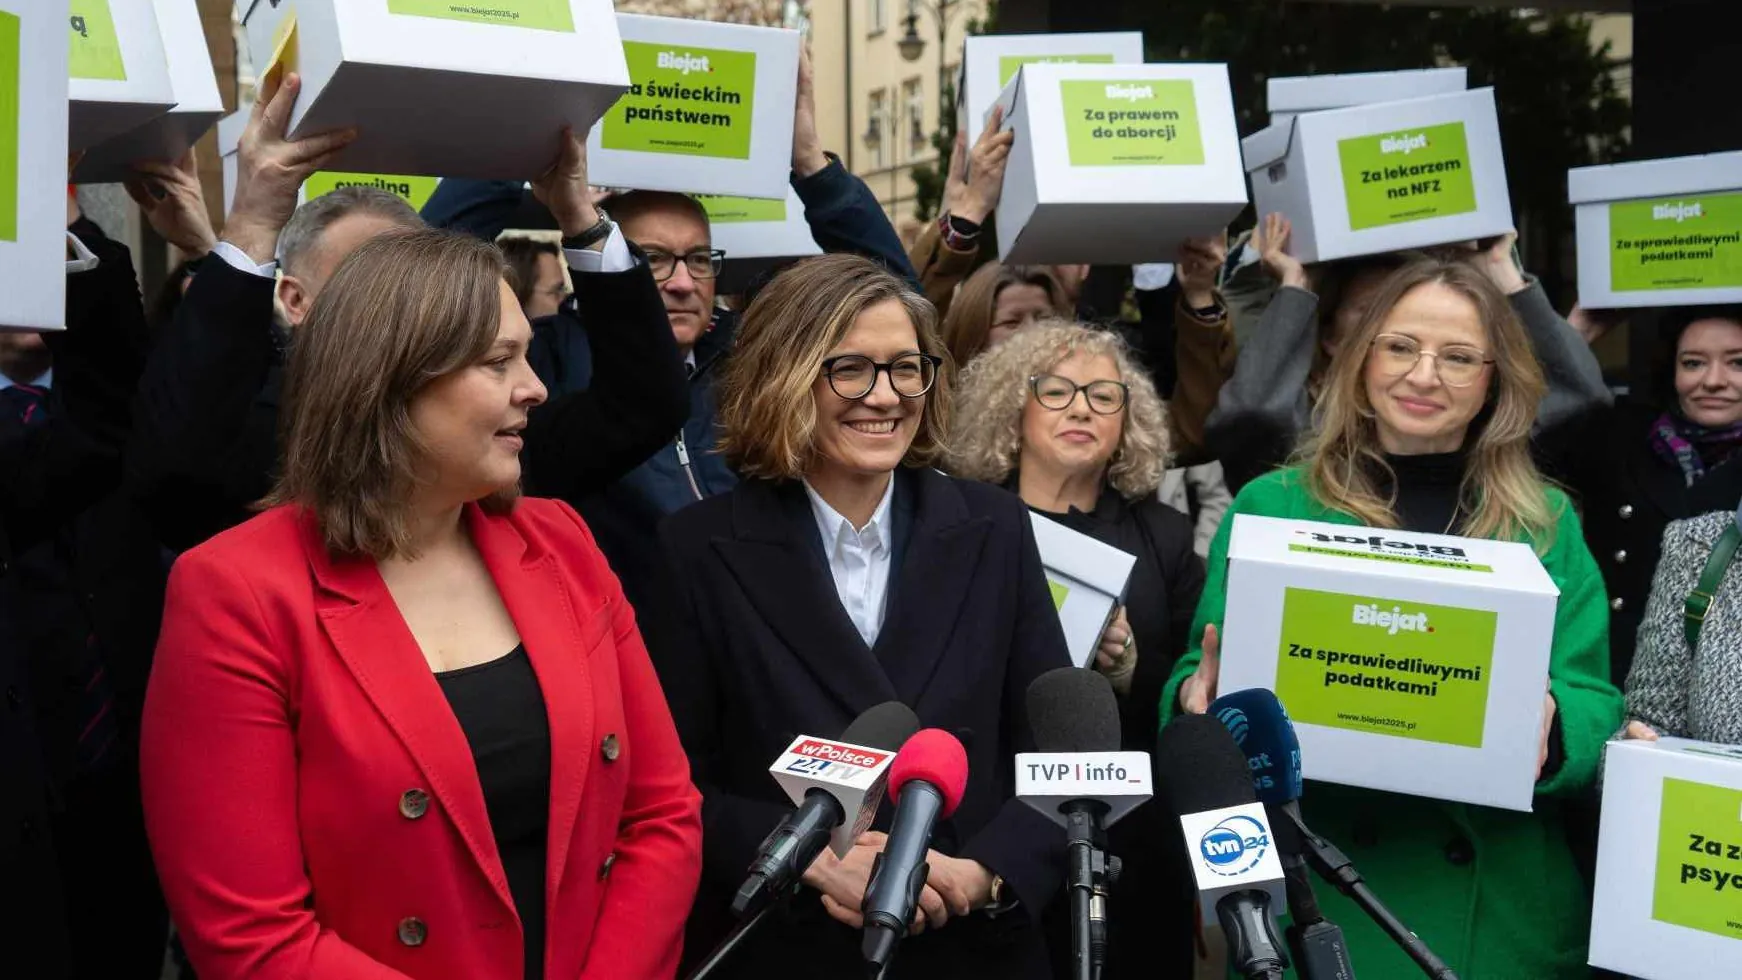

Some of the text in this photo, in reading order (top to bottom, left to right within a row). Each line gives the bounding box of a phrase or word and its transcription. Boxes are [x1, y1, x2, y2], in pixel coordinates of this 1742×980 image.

[647, 80, 741, 104] świeckim
[625, 104, 731, 127] państwem
[1084, 109, 1179, 124] Za prawem
[1092, 125, 1176, 141] do aborcji
[1361, 159, 1461, 183] Za lekarzem
[1387, 179, 1442, 199] na NFZ
[1616, 231, 1740, 251] Za sprawiedliwymi
[1641, 247, 1713, 265] podatkami
[1288, 643, 1481, 682] Za sprawiedliwymi
[1324, 670, 1437, 697] podatkami
[1337, 711, 1416, 730] www.biejat2025.pl
[801, 743, 876, 766] wPolsce
[1027, 763, 1070, 781] TVP
[1689, 833, 1722, 857] Za
